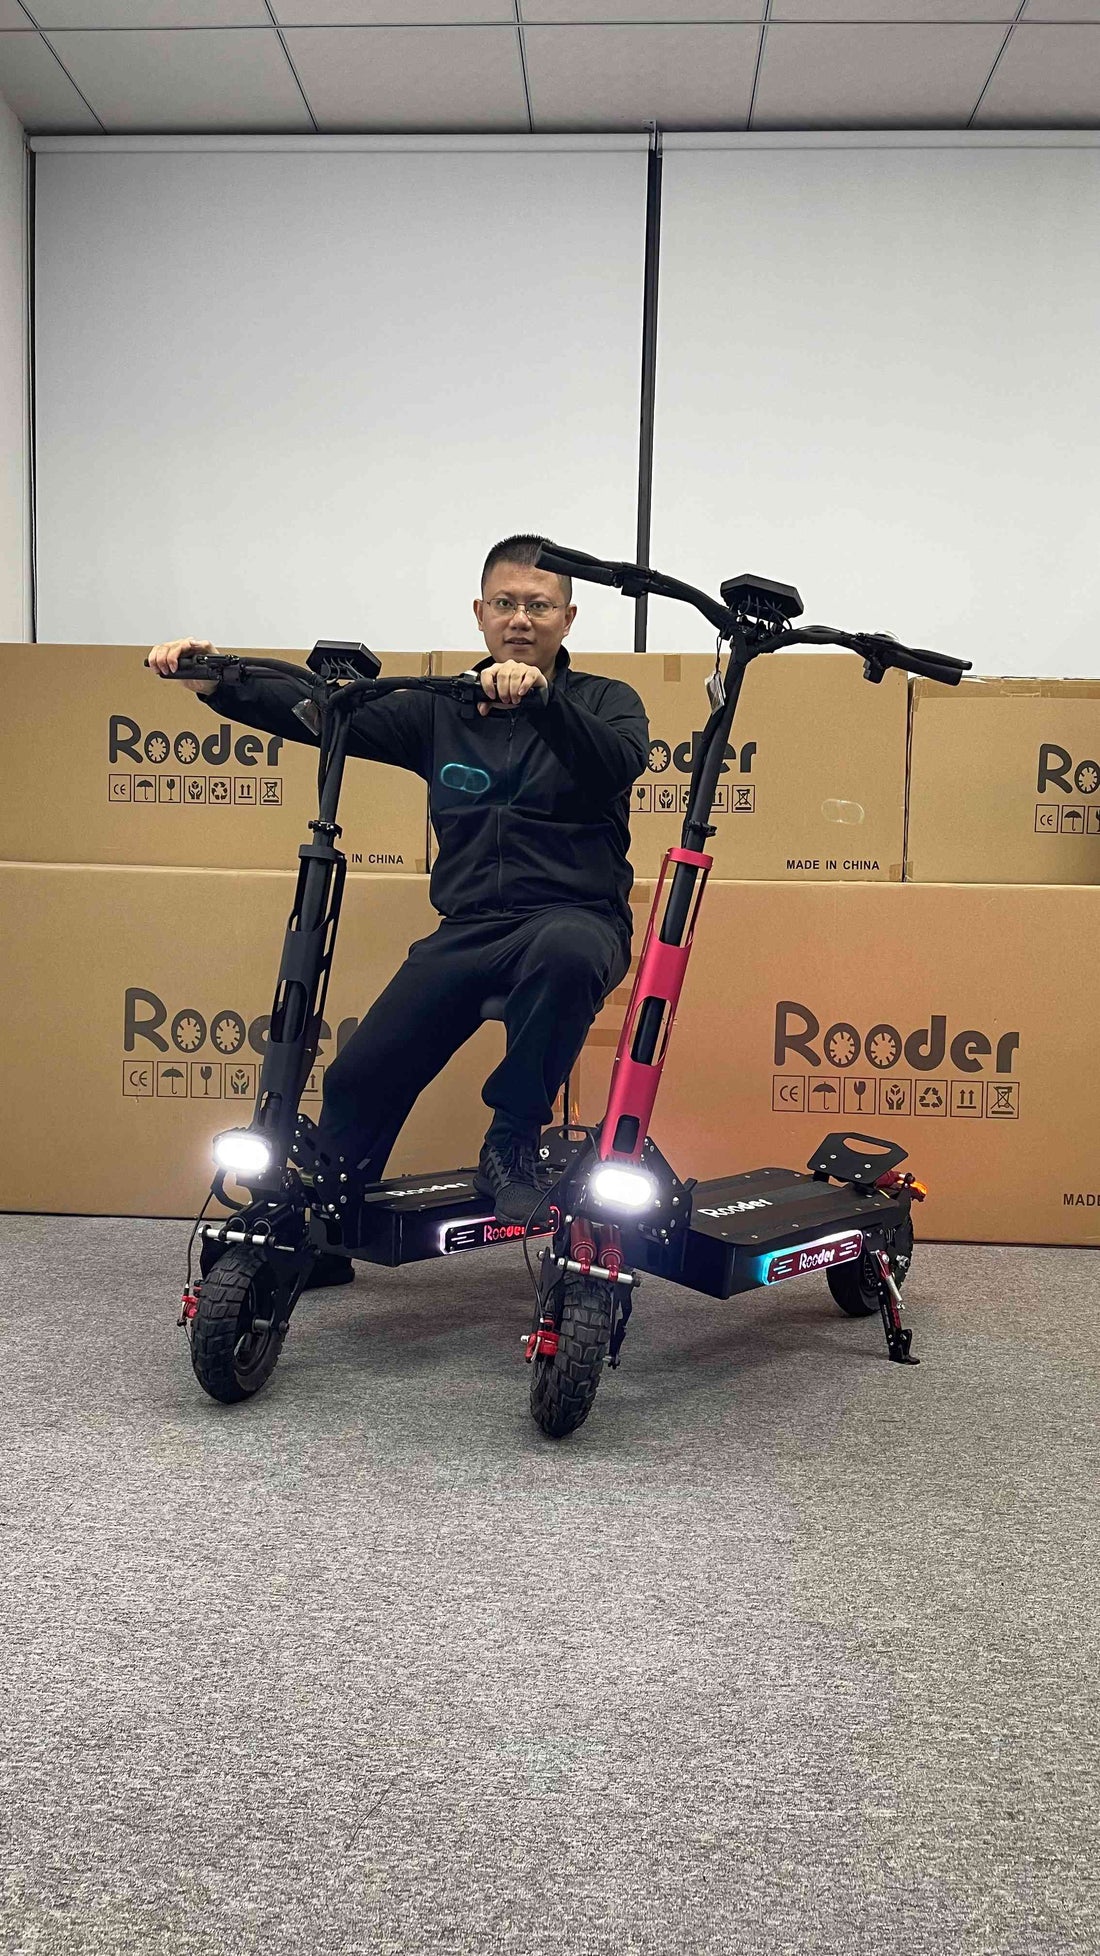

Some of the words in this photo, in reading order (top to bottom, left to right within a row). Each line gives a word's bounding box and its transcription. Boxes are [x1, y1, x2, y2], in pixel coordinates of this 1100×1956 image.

[109, 714, 284, 767] Rooder
[1037, 743, 1100, 795] Ro
[351, 853, 363, 863] IN
[368, 854, 404, 864] CHINA
[786, 859, 820, 870] MADE
[825, 860, 837, 870] IN
[842, 860, 880, 870] CHINA
[773, 1000, 1020, 1074] Rooder
[697, 1198, 774, 1218] Rooder
[798, 1248, 836, 1271] Rooder
